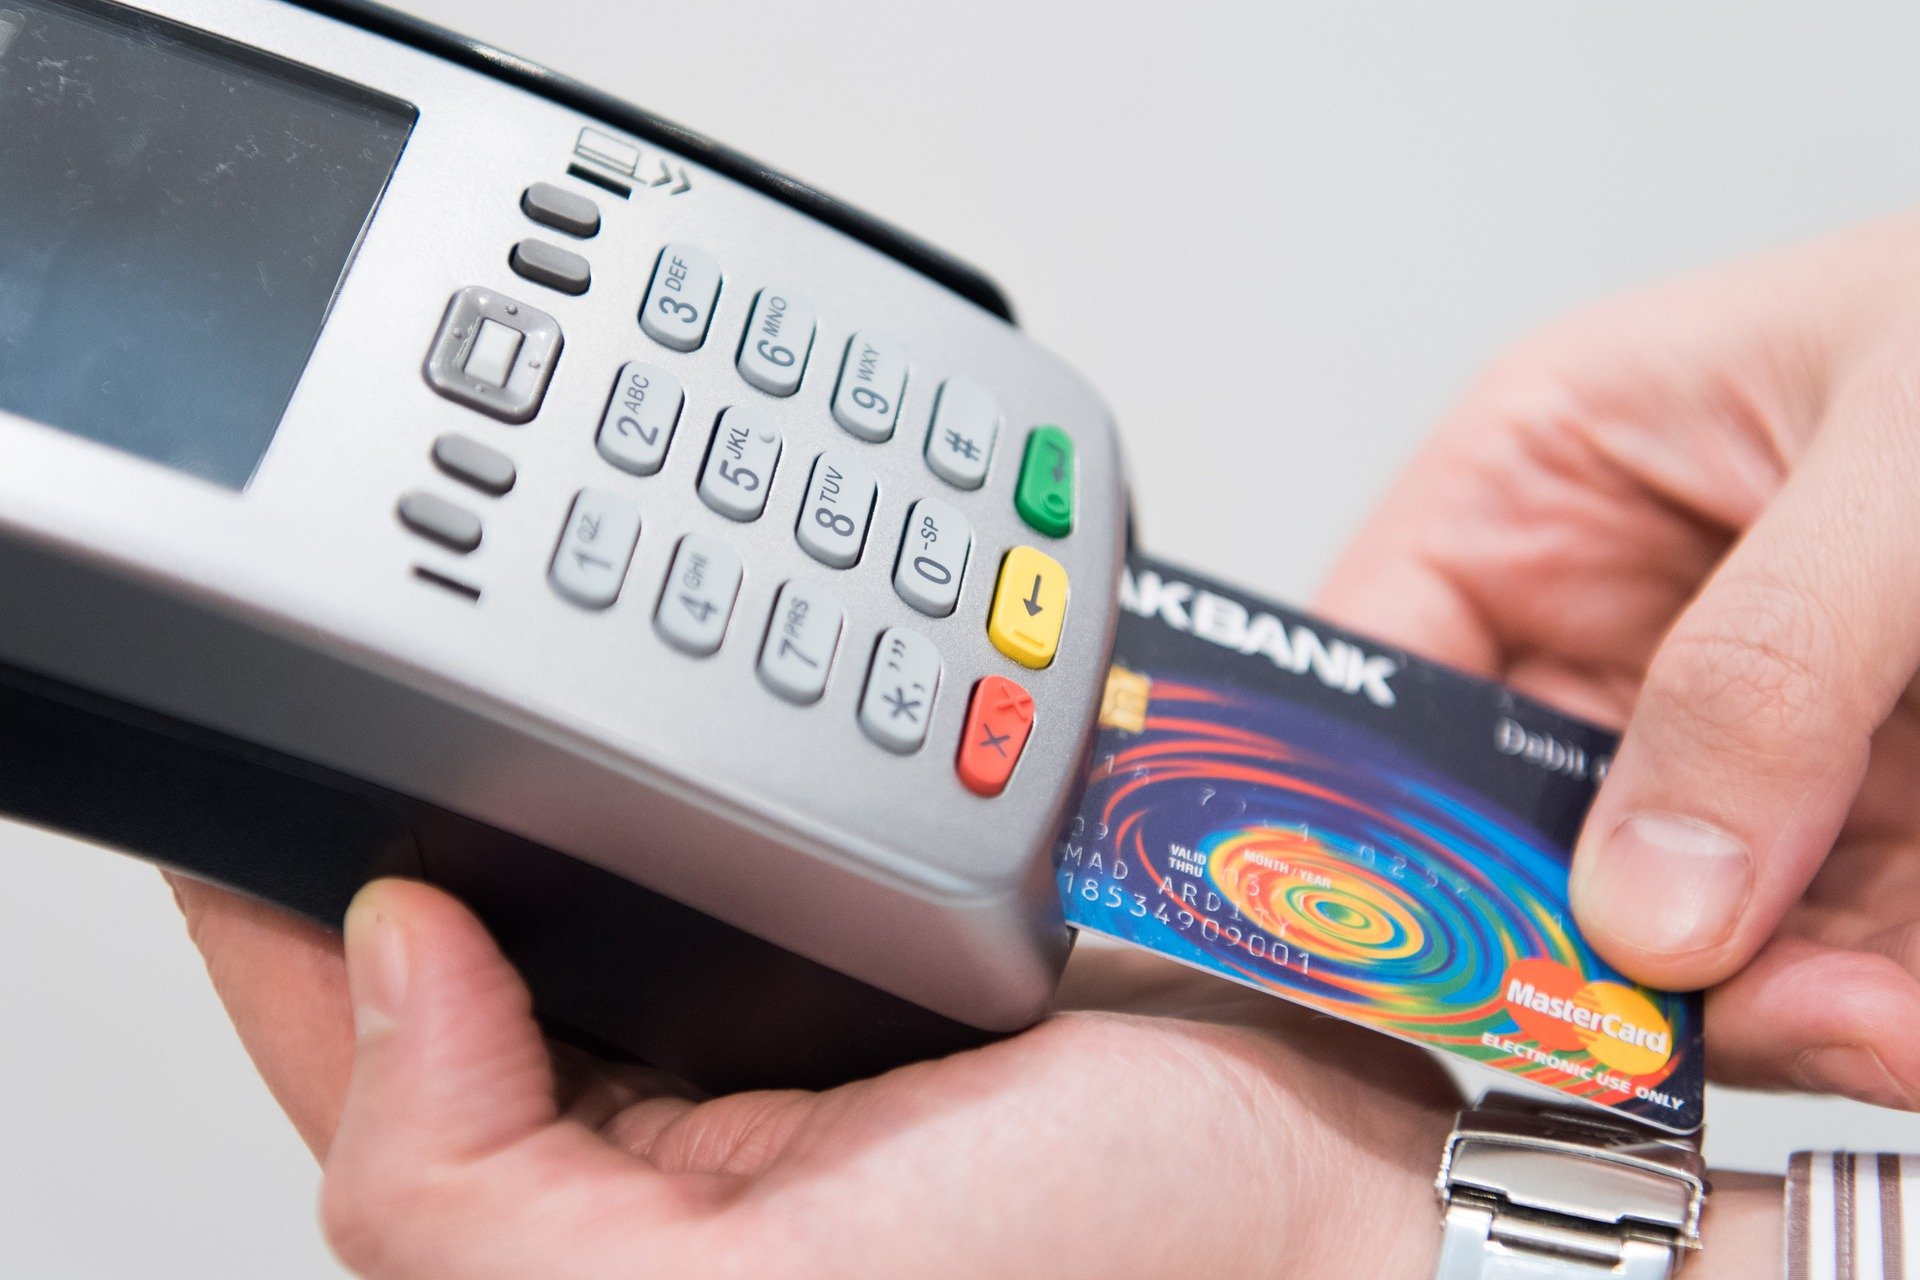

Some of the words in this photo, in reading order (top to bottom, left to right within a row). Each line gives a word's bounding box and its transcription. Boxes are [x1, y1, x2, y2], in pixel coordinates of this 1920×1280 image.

[664, 256, 689, 292] DEF
[658, 295, 698, 323] 3
[762, 296, 787, 337] MNO
[757, 339, 795, 367] 6
[856, 343, 879, 382] WXY
[624, 374, 649, 415] ABC
[851, 386, 889, 415] 9
[617, 416, 658, 446] 2
[726, 427, 750, 460] JKL
[718, 459, 759, 491] 5
[820, 465, 843, 504] TUV
[576, 512, 601, 544] QZ
[815, 507, 855, 537] 8
[573, 547, 613, 571] 1
[682, 552, 708, 591] GHI
[913, 556, 951, 585] 0
[679, 593, 718, 625] 4
[783, 597, 810, 640] PRS
[776, 638, 818, 669] 7
[1495, 717, 1588, 782] Debit
[1169, 843, 1207, 866] VALID
[1169, 857, 1204, 879] THRU
[1243, 849, 1289, 875] MONTH
[1299, 869, 1333, 890] YEAR
[1506, 978, 1668, 1055] MasterCard
[1480, 1031, 1594, 1081] ELECTRONIC
[1596, 1071, 1633, 1094] USE
[1635, 1084, 1685, 1112] ONLY
